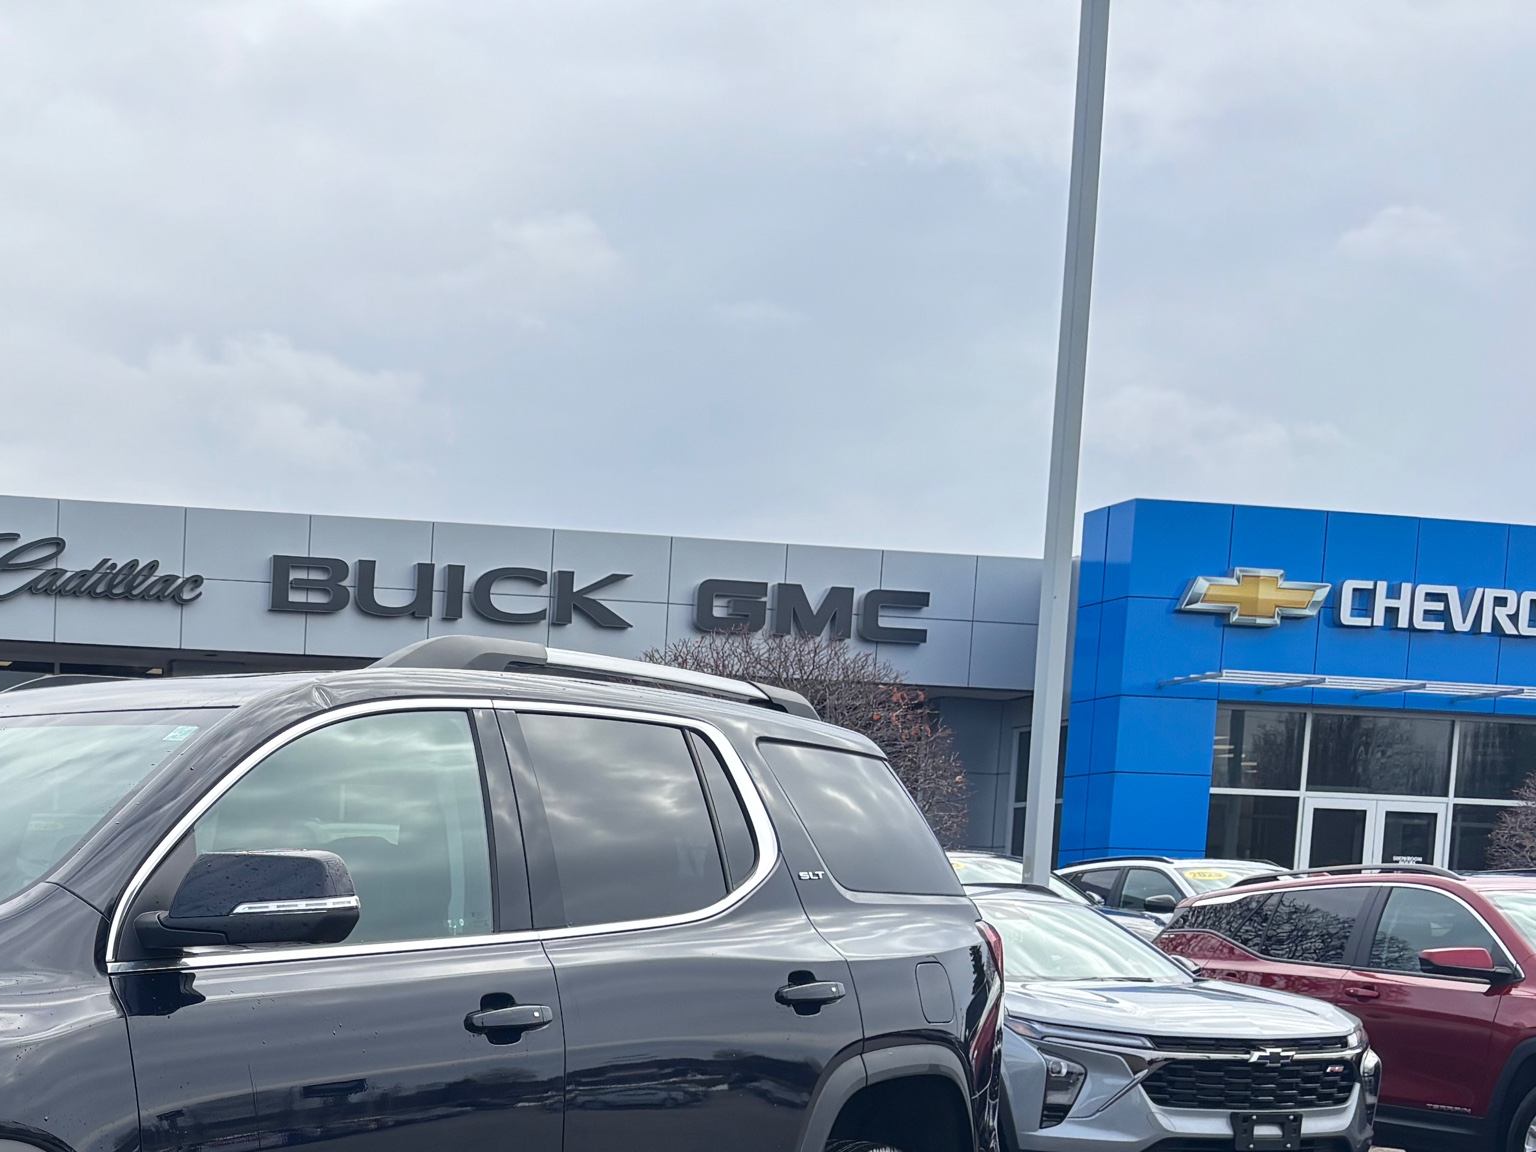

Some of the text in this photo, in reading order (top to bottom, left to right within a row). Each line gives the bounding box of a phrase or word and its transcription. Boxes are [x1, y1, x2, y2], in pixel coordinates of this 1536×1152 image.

[267, 555, 633, 628] BUICK
[693, 579, 931, 643] GMC
[798, 871, 825, 880] SLT
